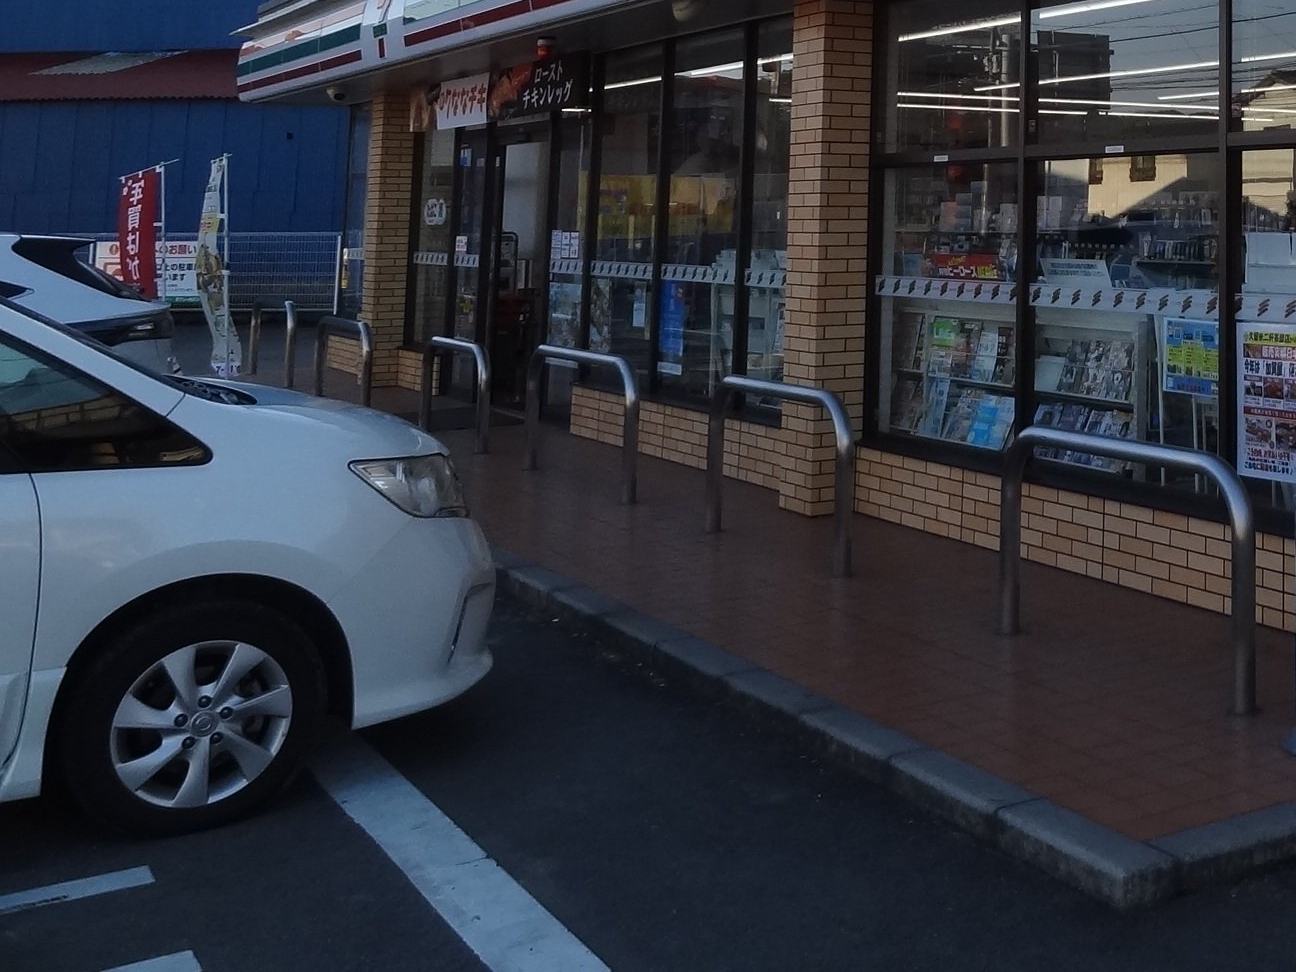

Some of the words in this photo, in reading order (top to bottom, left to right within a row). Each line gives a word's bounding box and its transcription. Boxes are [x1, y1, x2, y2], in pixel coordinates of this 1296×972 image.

[534, 59, 563, 84] ロースト
[523, 78, 573, 109] チキンレッグ
[156, 244, 197, 255] のお願い
